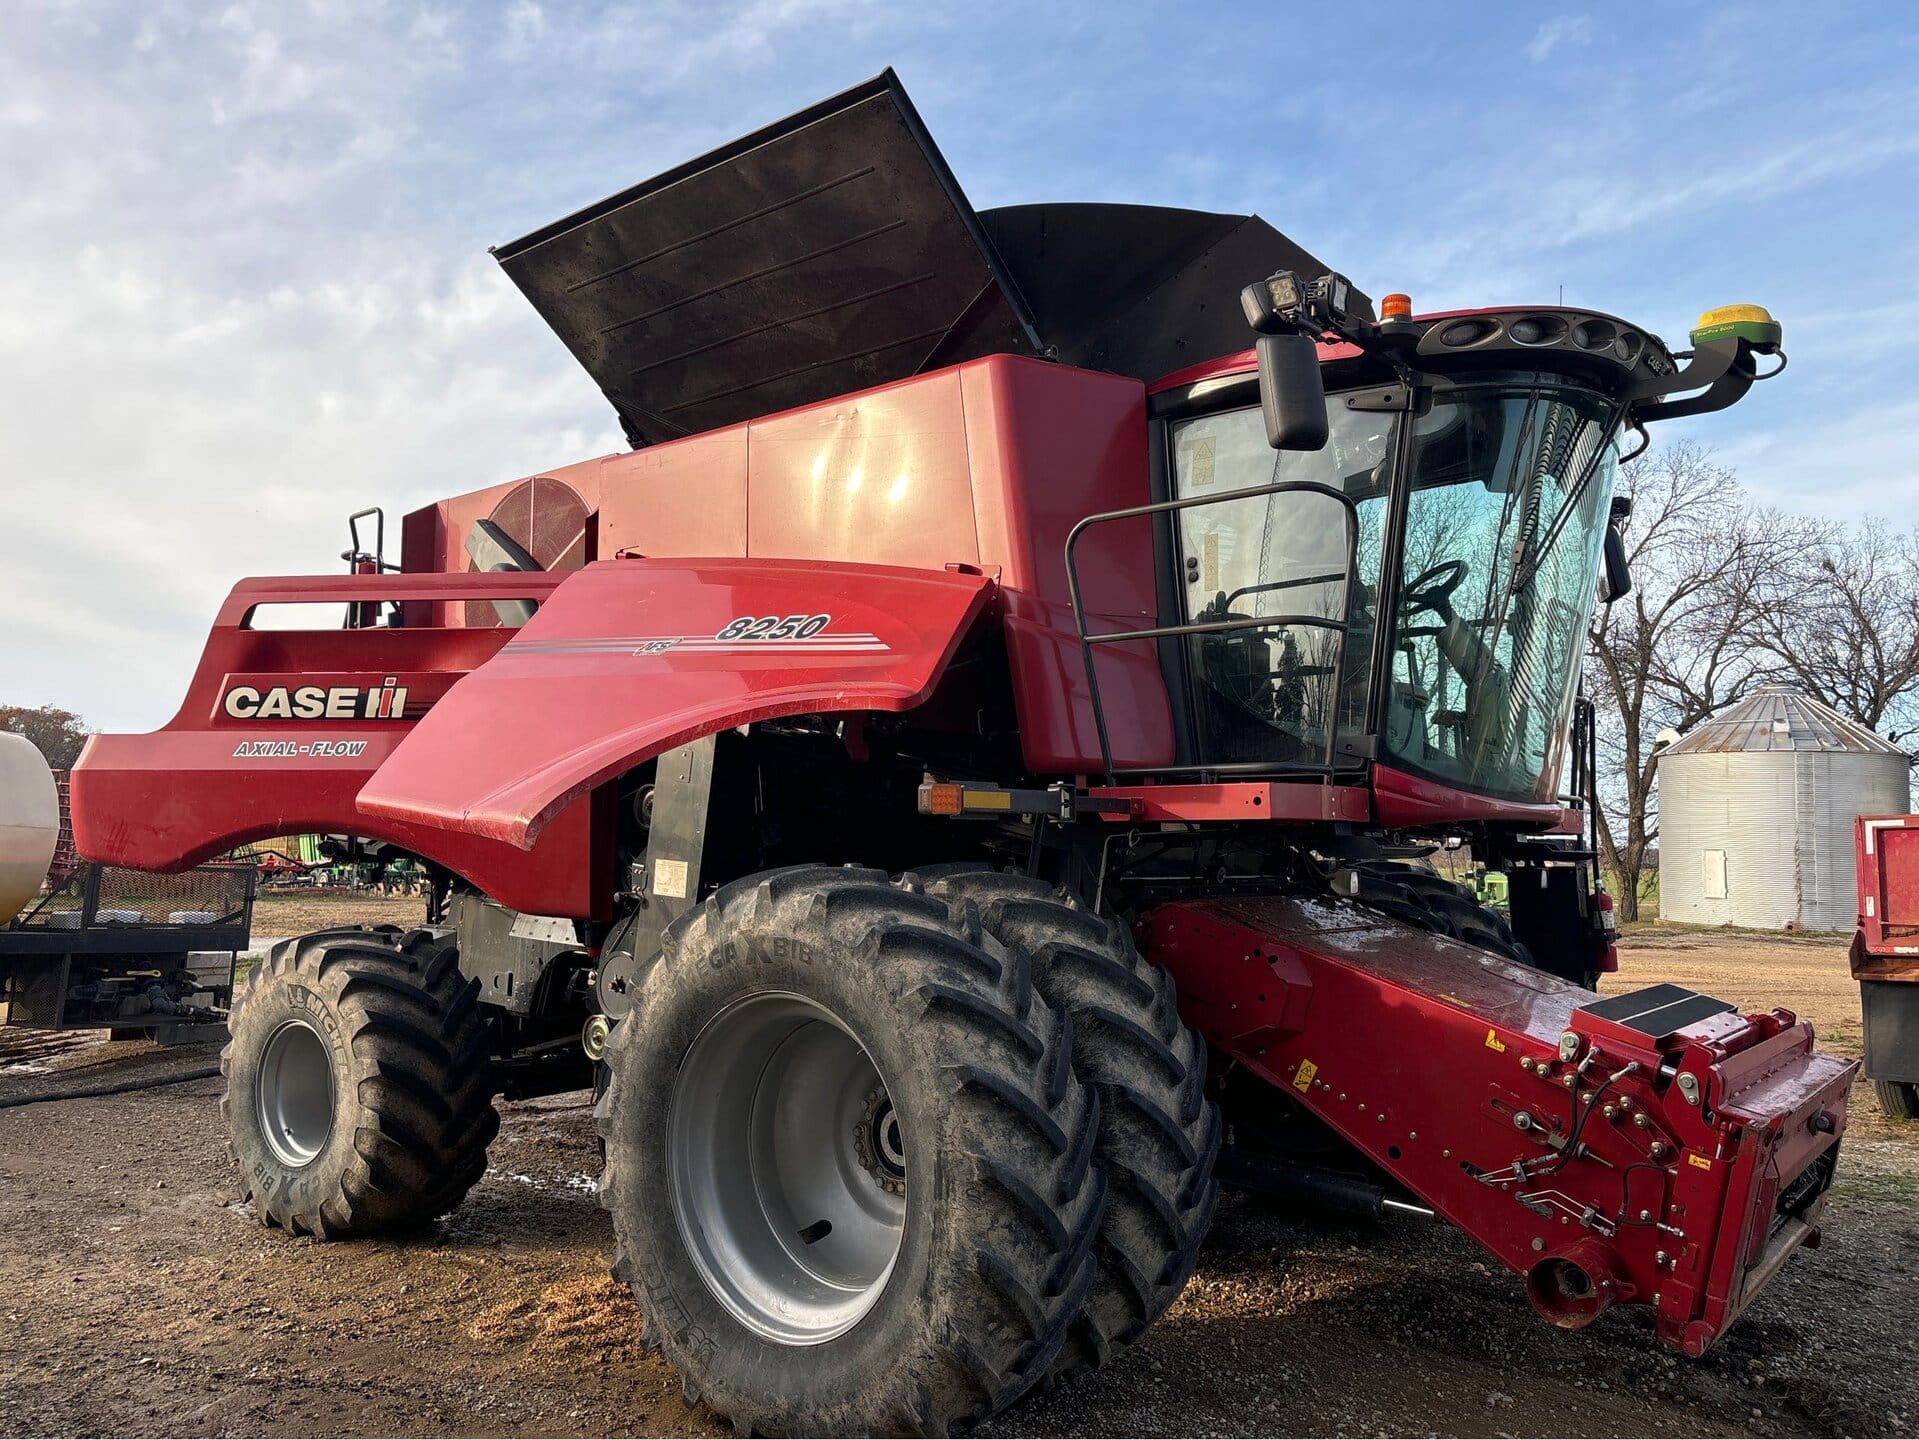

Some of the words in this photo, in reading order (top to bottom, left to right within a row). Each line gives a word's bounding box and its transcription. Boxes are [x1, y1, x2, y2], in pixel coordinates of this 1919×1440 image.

[715, 614, 831, 641] 8250
[225, 686, 359, 719] CASE
[232, 740, 368, 758] AXIAL-FLOW
